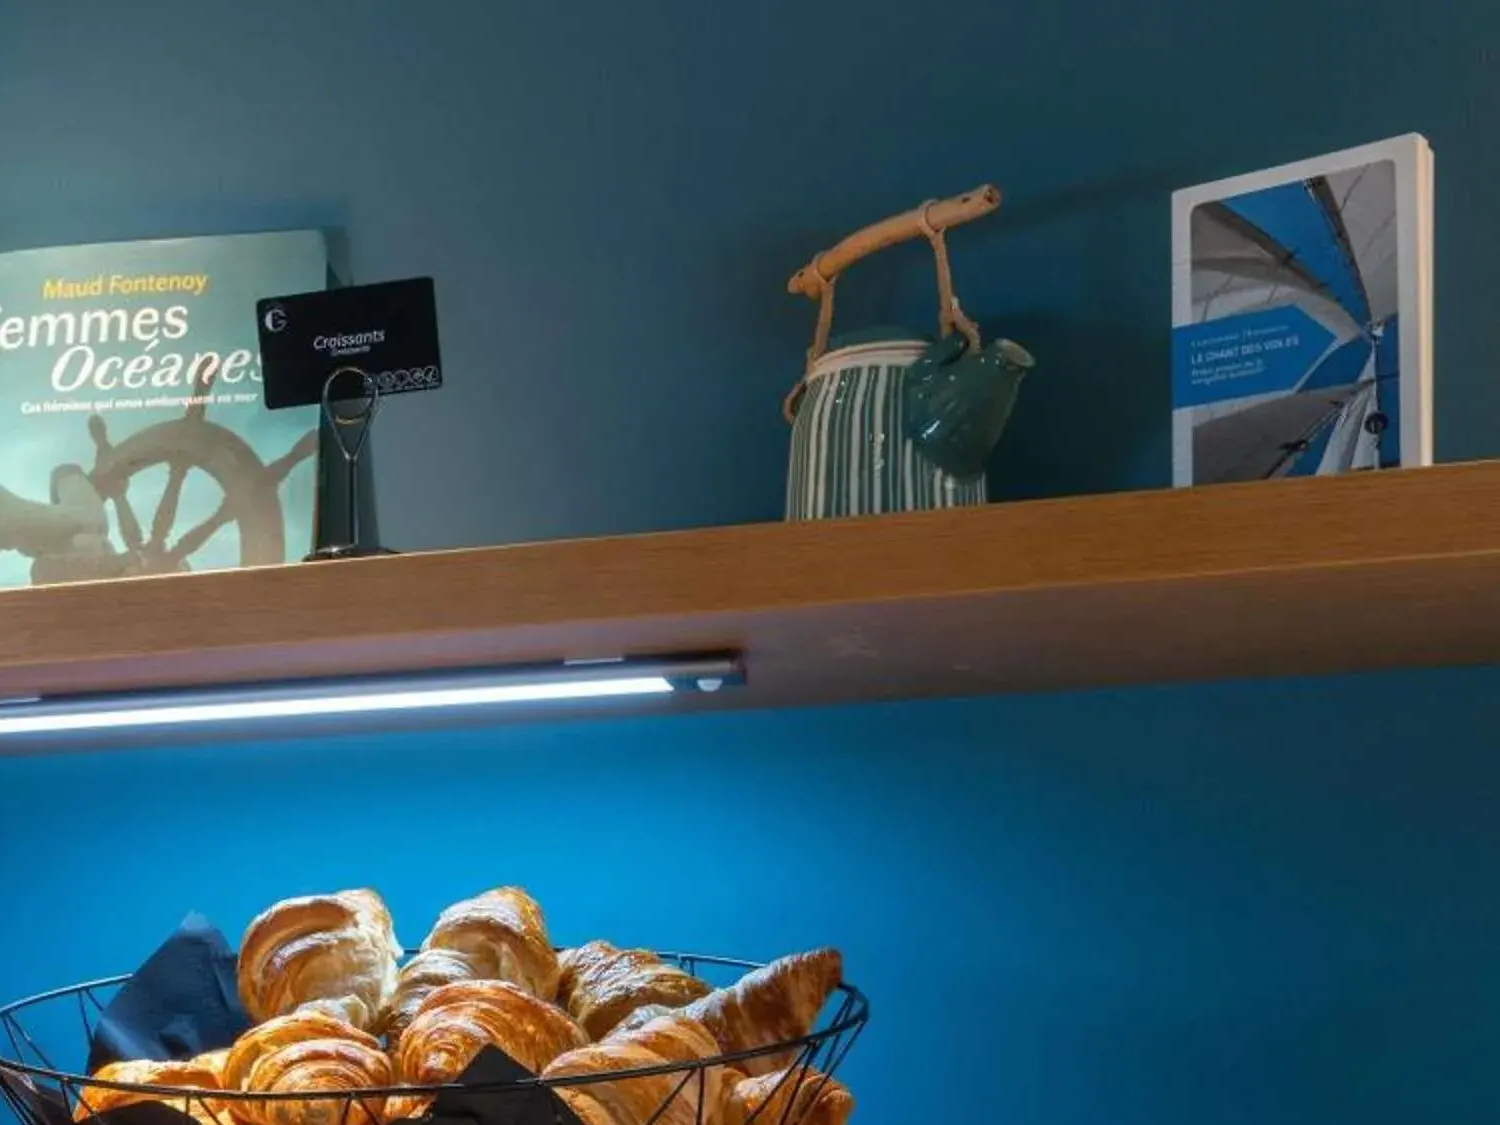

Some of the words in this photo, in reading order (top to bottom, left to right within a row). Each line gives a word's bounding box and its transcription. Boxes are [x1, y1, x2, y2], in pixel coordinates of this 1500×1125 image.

[42, 277, 103, 300] Maud
[108, 272, 208, 296] Fontenoy
[313, 329, 386, 350] Croissants
